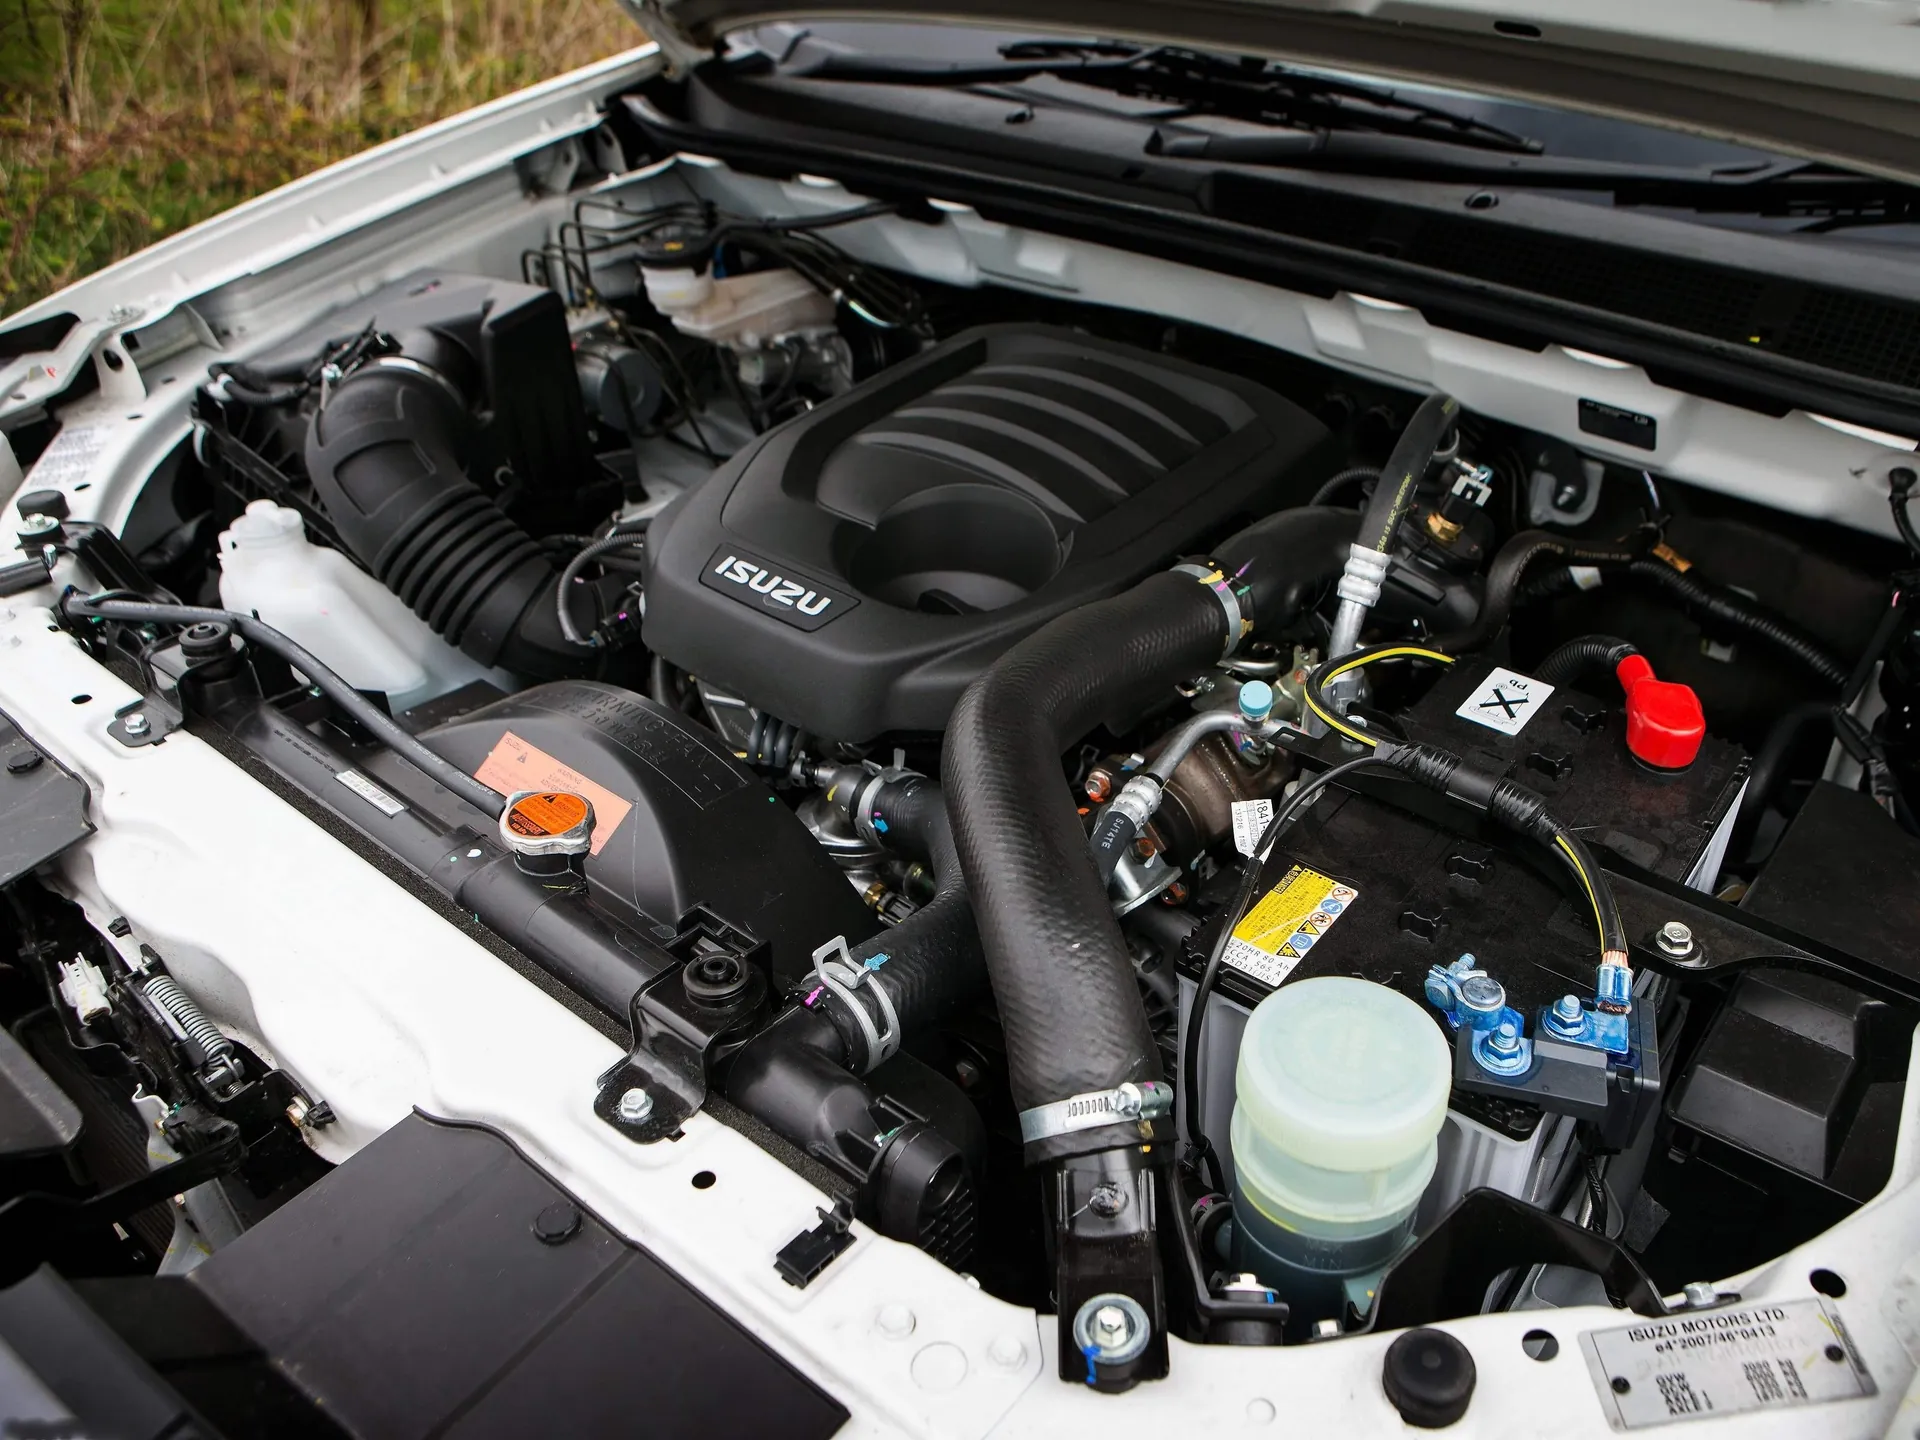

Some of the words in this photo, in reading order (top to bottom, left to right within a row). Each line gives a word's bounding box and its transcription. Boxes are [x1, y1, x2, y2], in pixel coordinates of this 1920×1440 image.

[714, 555, 832, 616] ISUZU
[1302, 1253, 1342, 1270] MIN
[1628, 1323, 1678, 1343] ISUZU
[1681, 1313, 1751, 1337] MOTORS
[1754, 1308, 1790, 1326] LTD.
